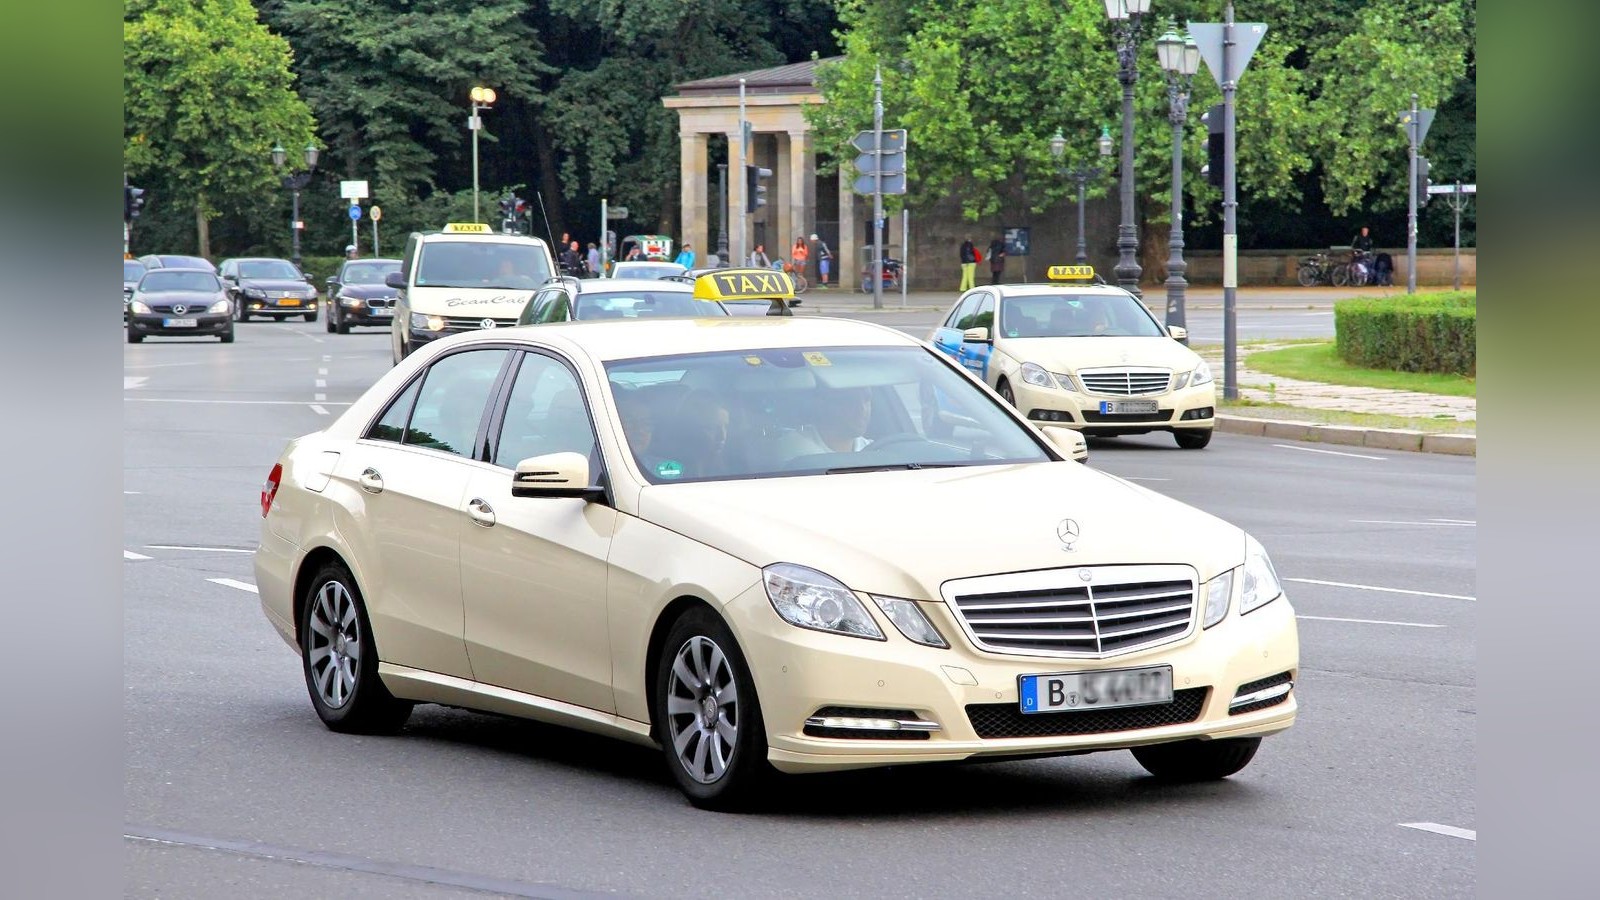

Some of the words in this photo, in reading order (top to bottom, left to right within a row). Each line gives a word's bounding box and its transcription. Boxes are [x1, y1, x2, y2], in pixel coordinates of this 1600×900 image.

[454, 224, 482, 232] TAXI
[1056, 267, 1088, 276] TAXI
[720, 275, 783, 294] TAXI
[445, 295, 526, 307] BeanCab
[1107, 402, 1113, 412] B
[1048, 679, 1065, 707] B
[1026, 697, 1034, 706] D
